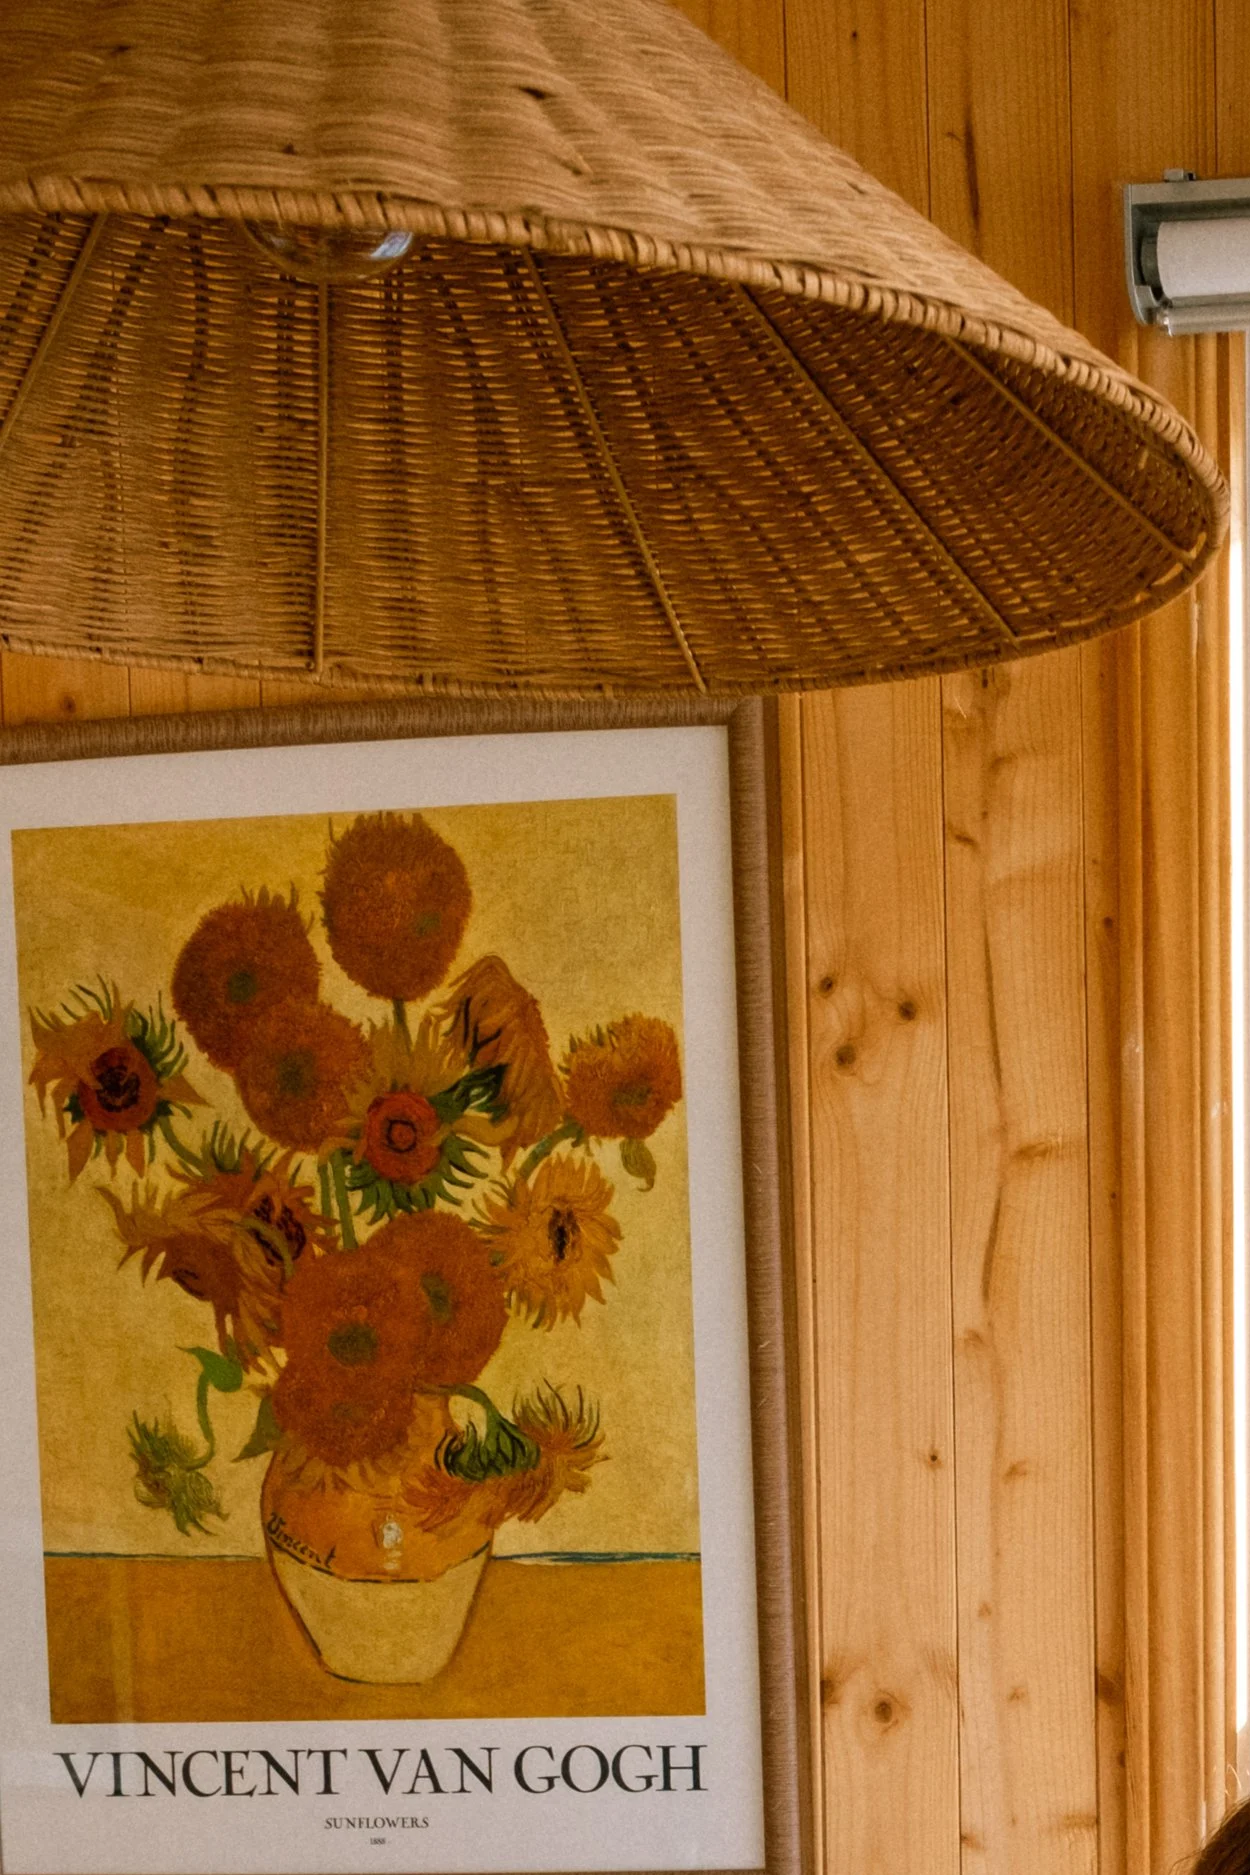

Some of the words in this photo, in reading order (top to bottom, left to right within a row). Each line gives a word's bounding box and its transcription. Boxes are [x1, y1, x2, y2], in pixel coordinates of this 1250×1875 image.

[52, 1748, 347, 1798] VINCENT
[358, 1747, 500, 1795] VAN
[513, 1744, 708, 1794] GOGH
[325, 1817, 429, 1829] SUNFLOWERS
